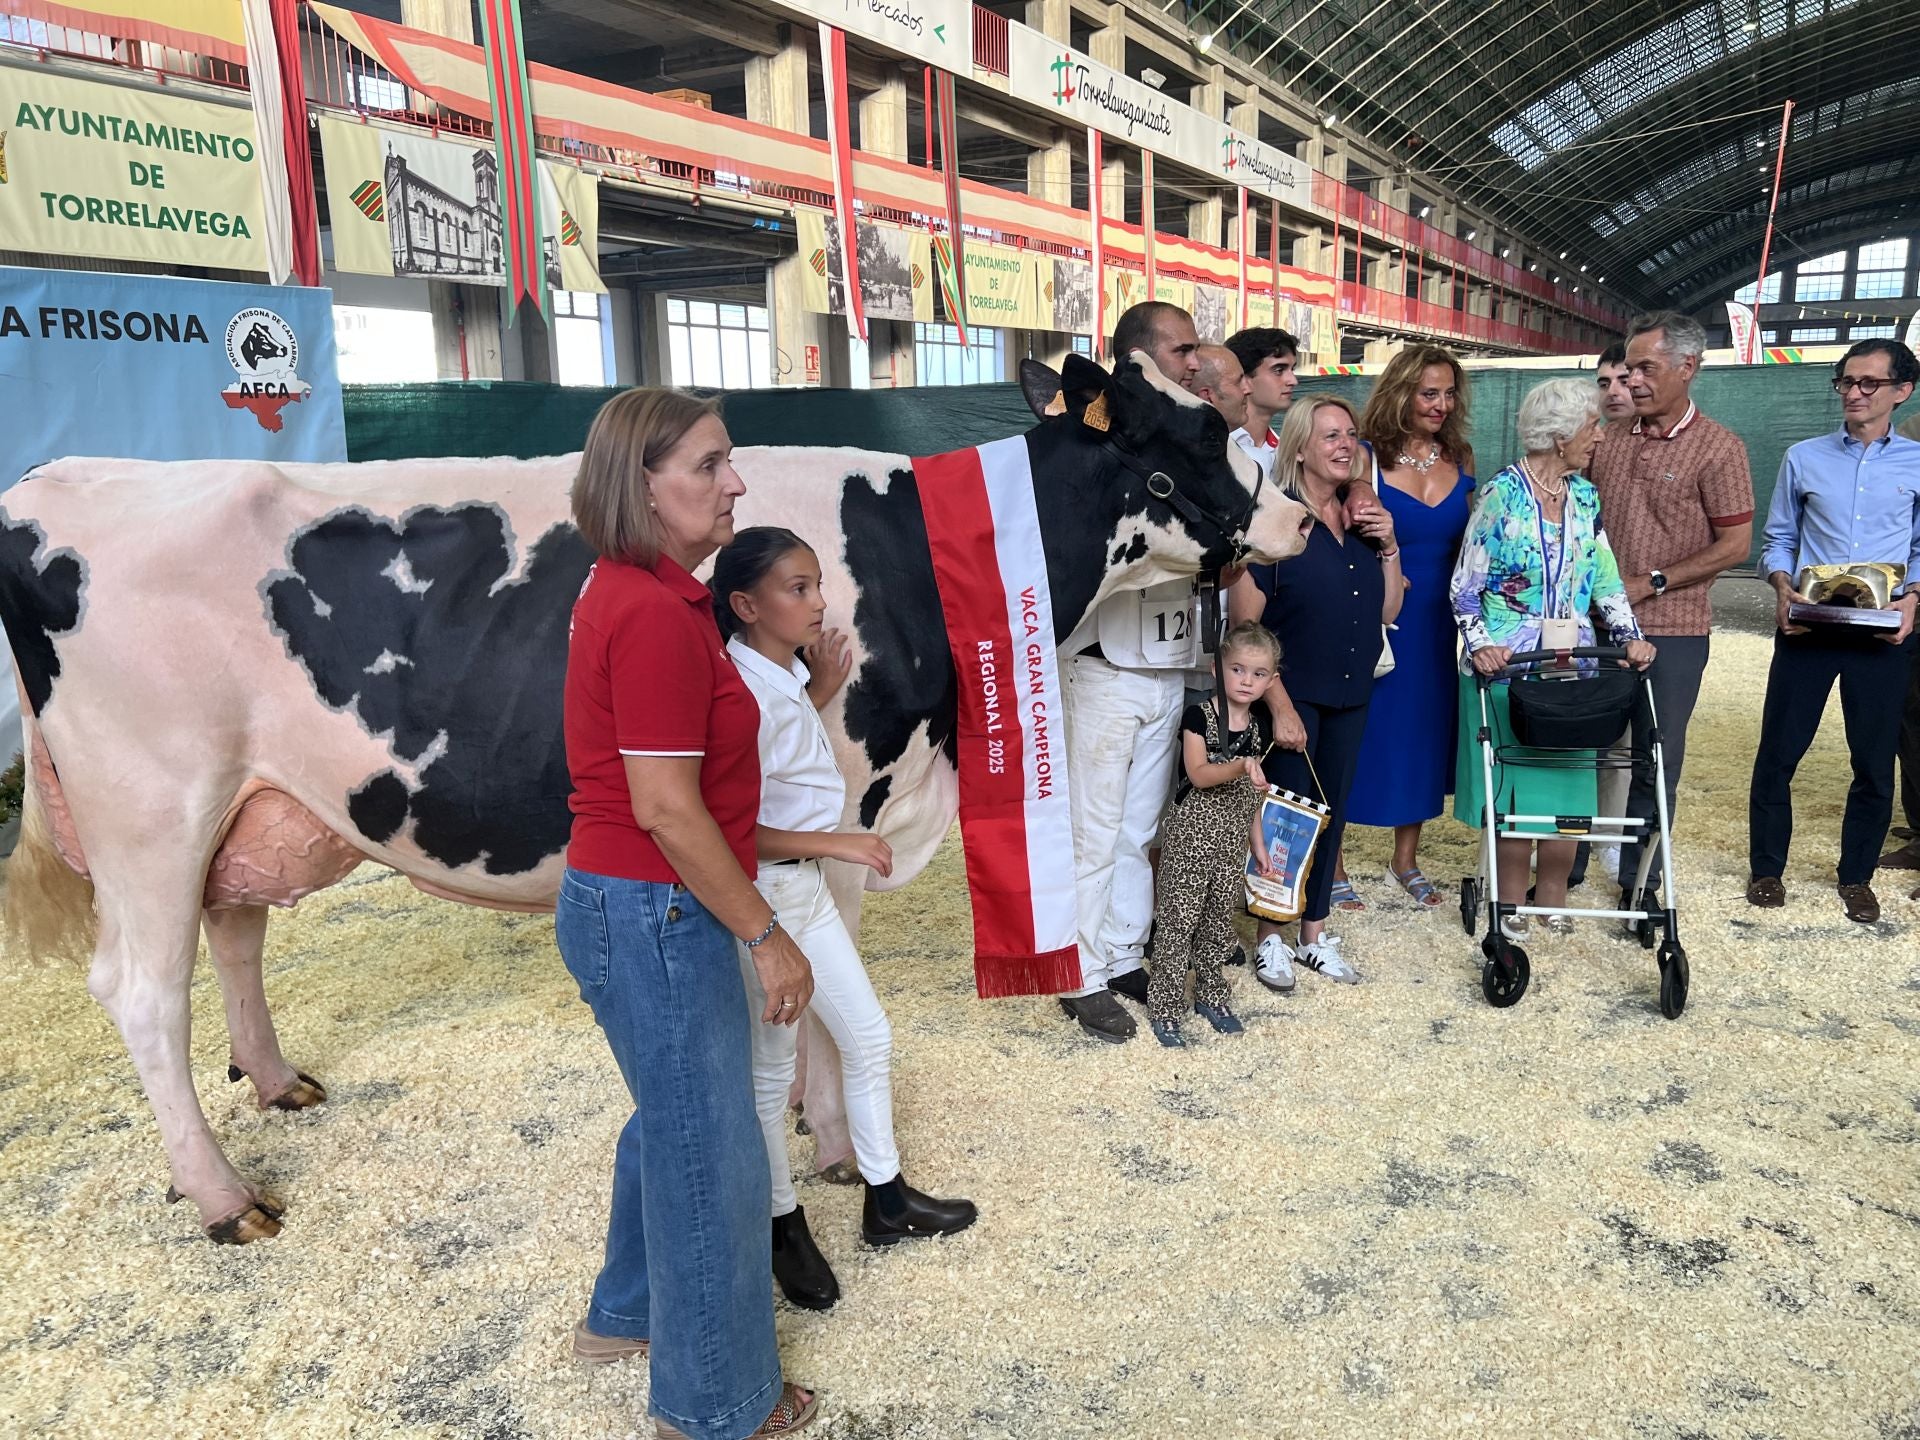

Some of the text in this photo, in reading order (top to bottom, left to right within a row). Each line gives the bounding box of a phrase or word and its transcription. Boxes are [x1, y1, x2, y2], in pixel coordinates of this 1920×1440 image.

[857, 0, 924, 36] ercados
[15, 102, 255, 163] AYUNTAMIENTO
[128, 160, 165, 190] DE
[40, 191, 252, 239] TORRELAVEGA
[964, 253, 1021, 274] AYUNTAMIENTO
[989, 277, 999, 290] DE
[969, 294, 1018, 312] TORRELAVEGA
[38, 306, 210, 344] FRISONA
[226, 310, 298, 369] ASOCIACIÓN FRISONA DE CANTABRIA
[240, 382, 291, 399] AFCA
[977, 639, 1005, 775] REGIONAL 2025
[1020, 586, 1053, 800] VACA GRAN CAMPEONA
